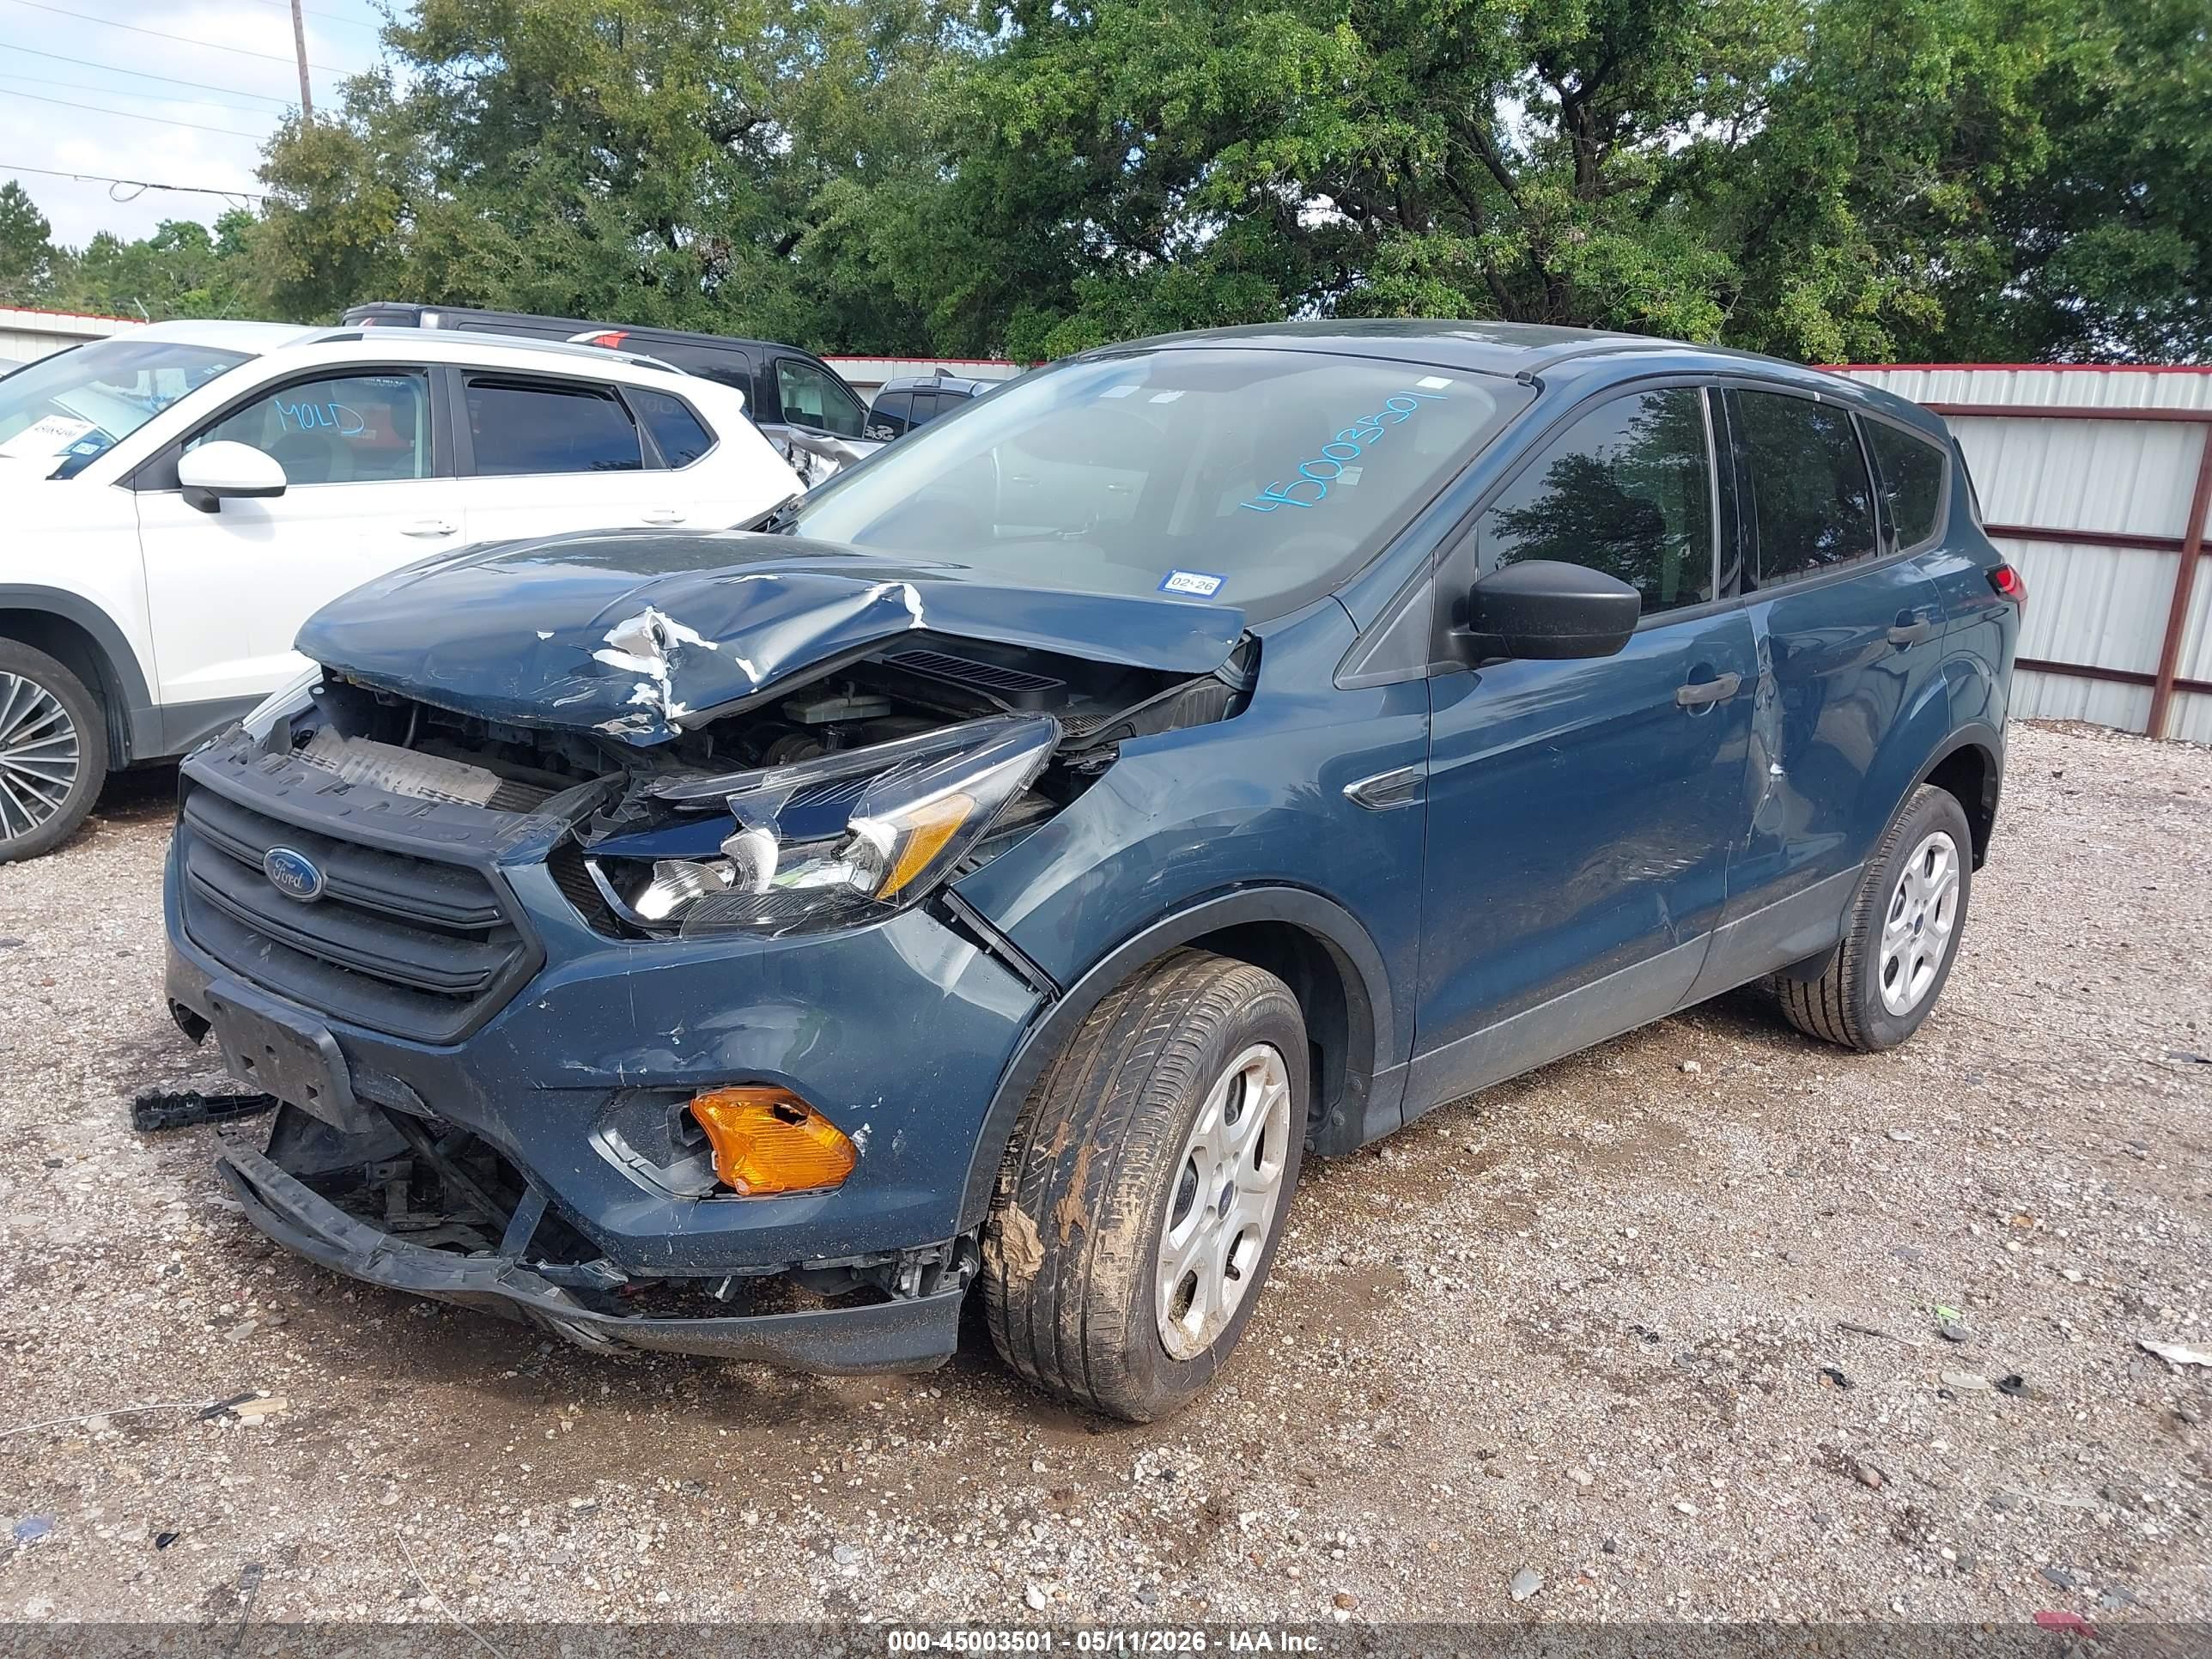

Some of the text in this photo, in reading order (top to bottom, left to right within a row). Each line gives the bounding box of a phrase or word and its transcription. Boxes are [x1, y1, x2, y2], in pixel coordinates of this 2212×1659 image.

[274, 399, 365, 435] MOLD
[1240, 390, 1449, 512] 45003501
[272, 858, 305, 890] Ford
